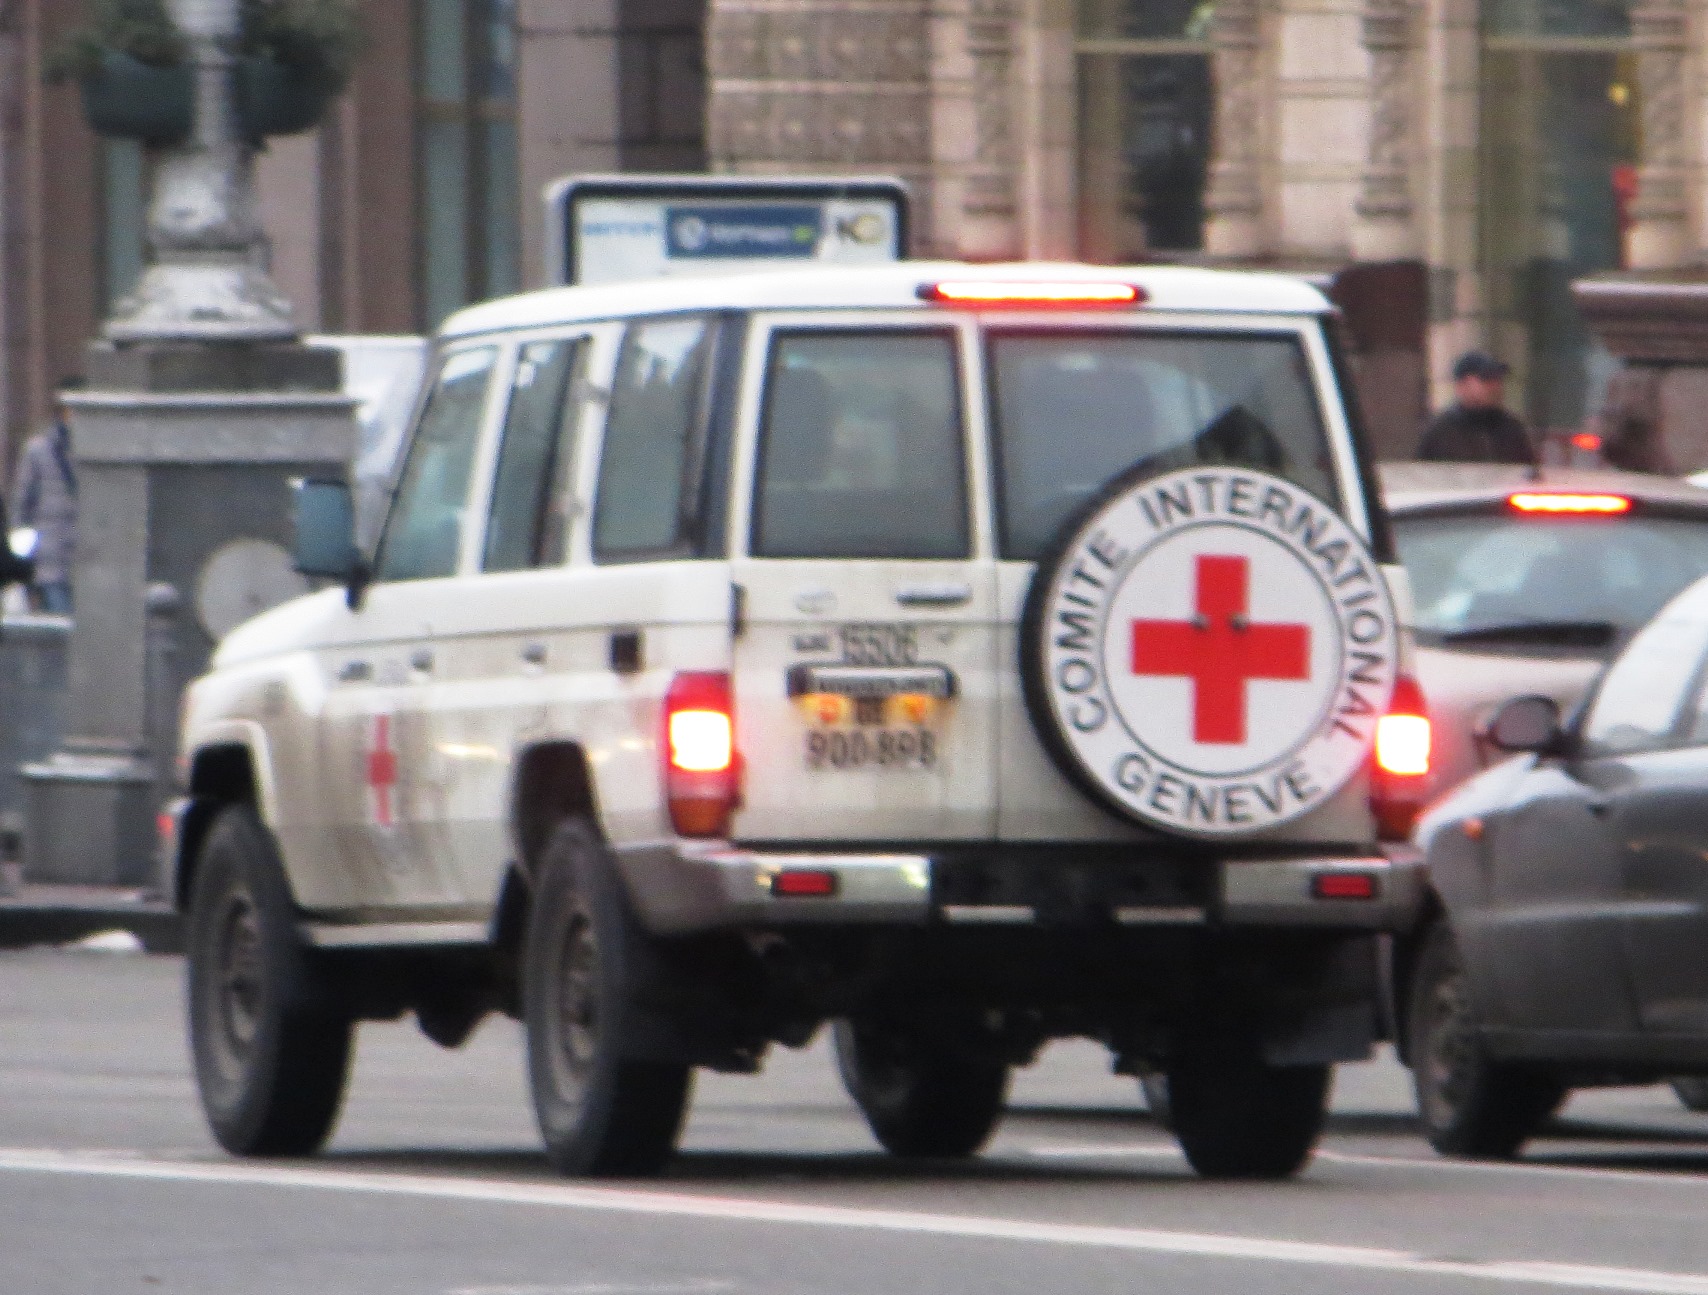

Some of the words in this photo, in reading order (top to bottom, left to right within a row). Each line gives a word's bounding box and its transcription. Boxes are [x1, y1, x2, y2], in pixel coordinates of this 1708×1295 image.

[1056, 530, 1130, 733] COMITE
[1138, 474, 1384, 742] INTERNATIONAL
[1113, 750, 1322, 824] GENEVE
